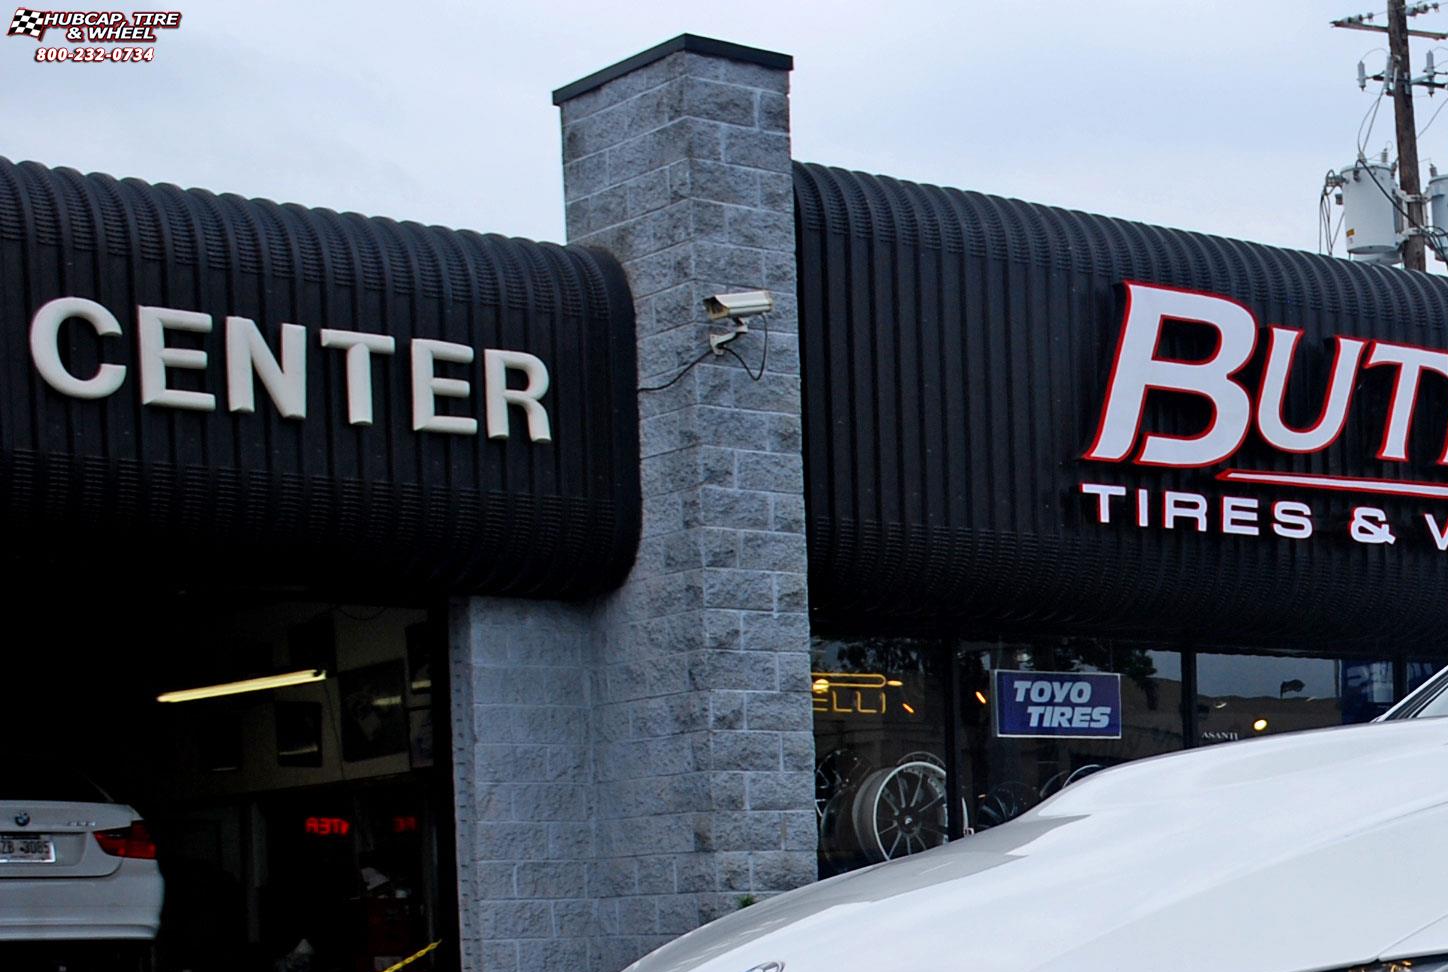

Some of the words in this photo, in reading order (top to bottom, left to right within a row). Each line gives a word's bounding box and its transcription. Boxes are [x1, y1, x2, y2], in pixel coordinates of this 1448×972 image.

[30, 296, 552, 443] CENTER
[1080, 482, 1313, 540] TIRES
[1350, 506, 1396, 545] &
[1013, 681, 1092, 703] TOYO
[1027, 706, 1111, 728] TIRES
